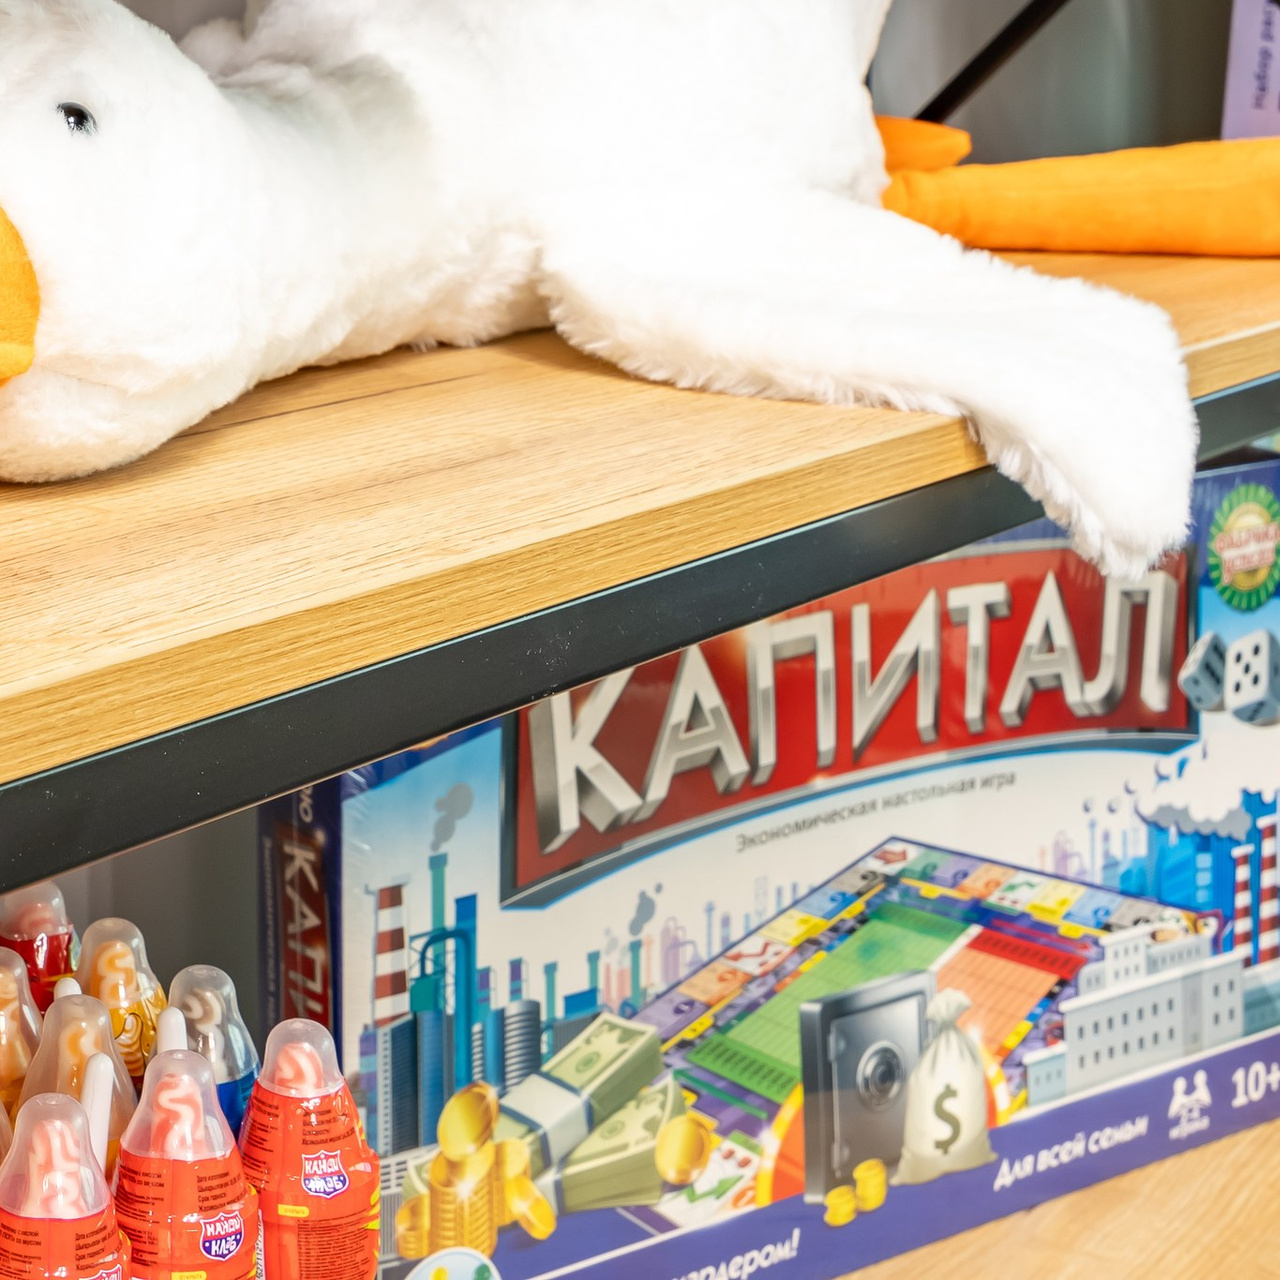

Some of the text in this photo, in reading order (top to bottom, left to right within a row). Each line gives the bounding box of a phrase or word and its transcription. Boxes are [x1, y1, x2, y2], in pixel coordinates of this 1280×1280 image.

[528, 568, 1177, 855] КАПИТАЛ
[736, 770, 1017, 853] Экономическая настольная игра
[282, 842, 323, 1018] КАПИ
[1231, 1061, 1280, 1109] 10+
[993, 1114, 1149, 1192] Для всей семьи
[673, 1228, 801, 1280] ардером!
